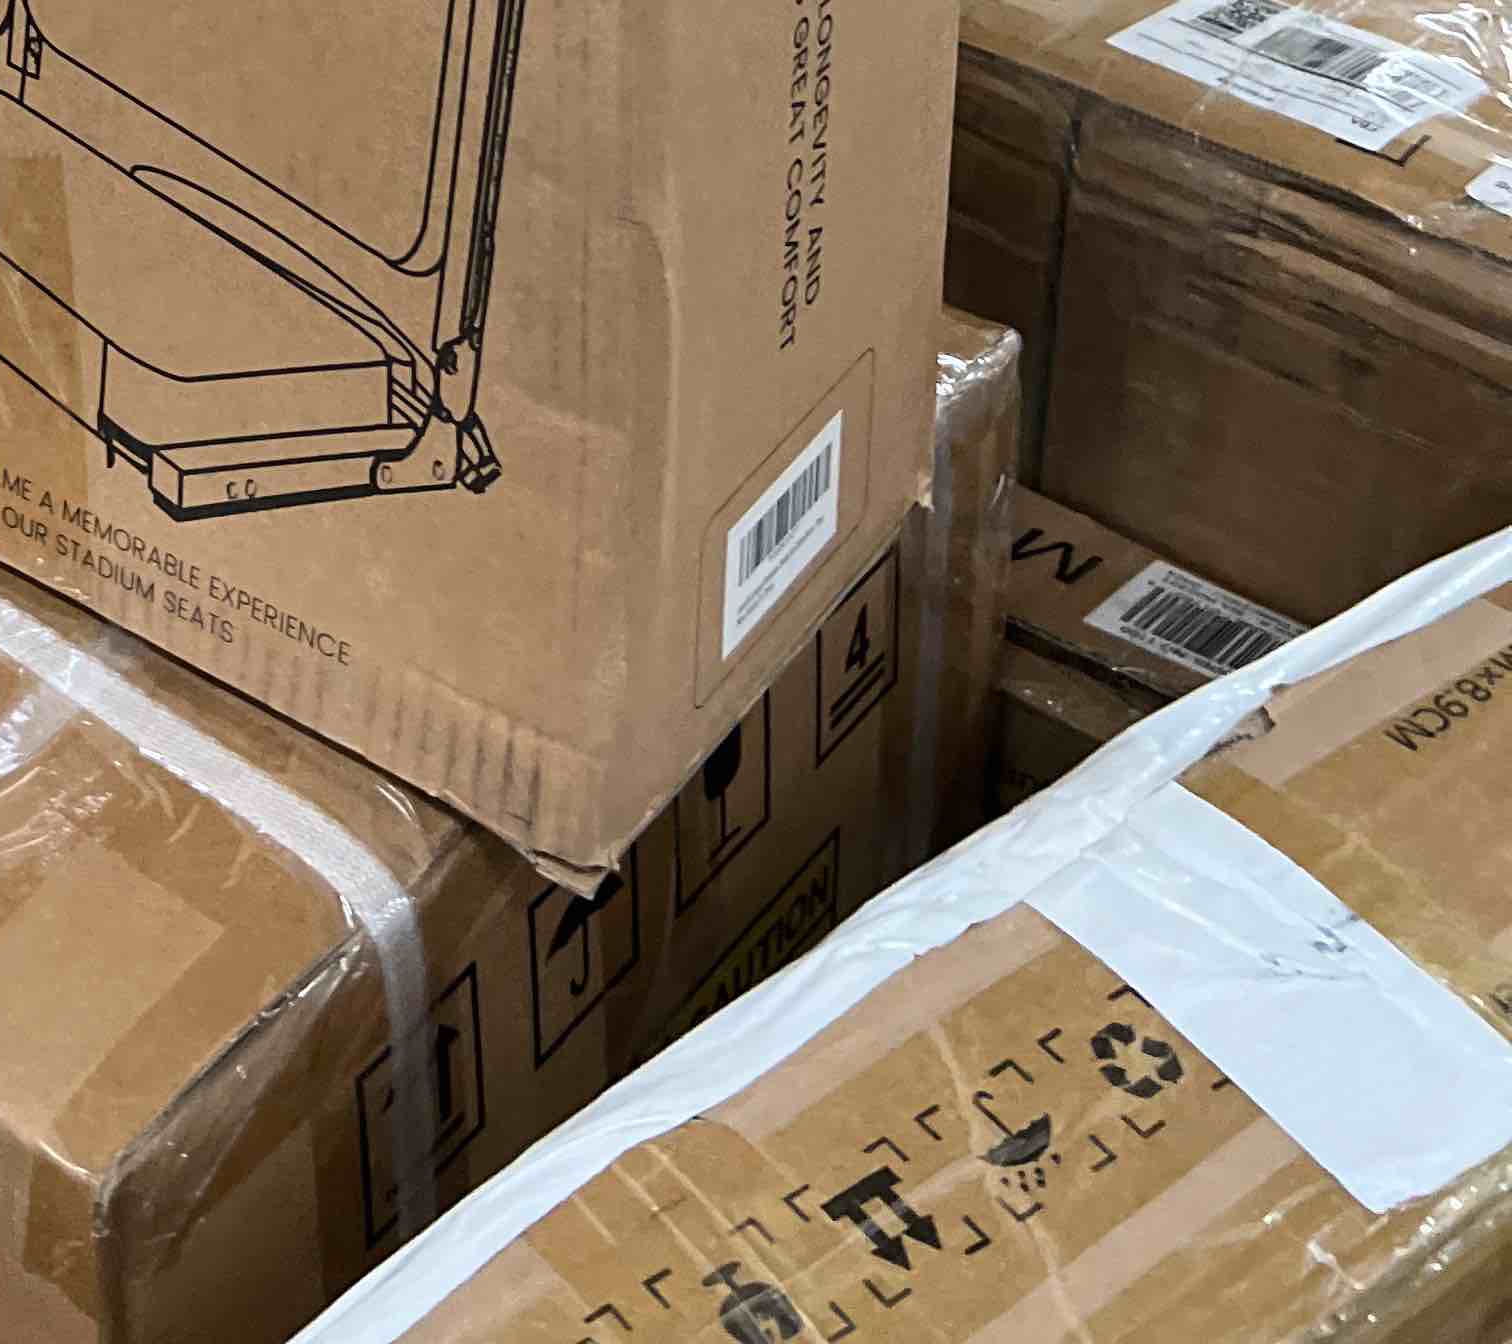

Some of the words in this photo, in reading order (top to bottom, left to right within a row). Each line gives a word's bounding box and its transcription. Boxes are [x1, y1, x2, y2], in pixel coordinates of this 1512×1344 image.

[788, 15, 811, 144] GREAT
[778, 157, 804, 352] COMFORT
[803, 225, 824, 307] AND
[0, 508, 49, 547] OUR
[54, 532, 156, 602] STADIUM
[162, 590, 236, 644] SEATS
[38, 490, 56, 512] A
[61, 500, 201, 591] MEMORABLE
[208, 576, 353, 667] EXPERIENCE
